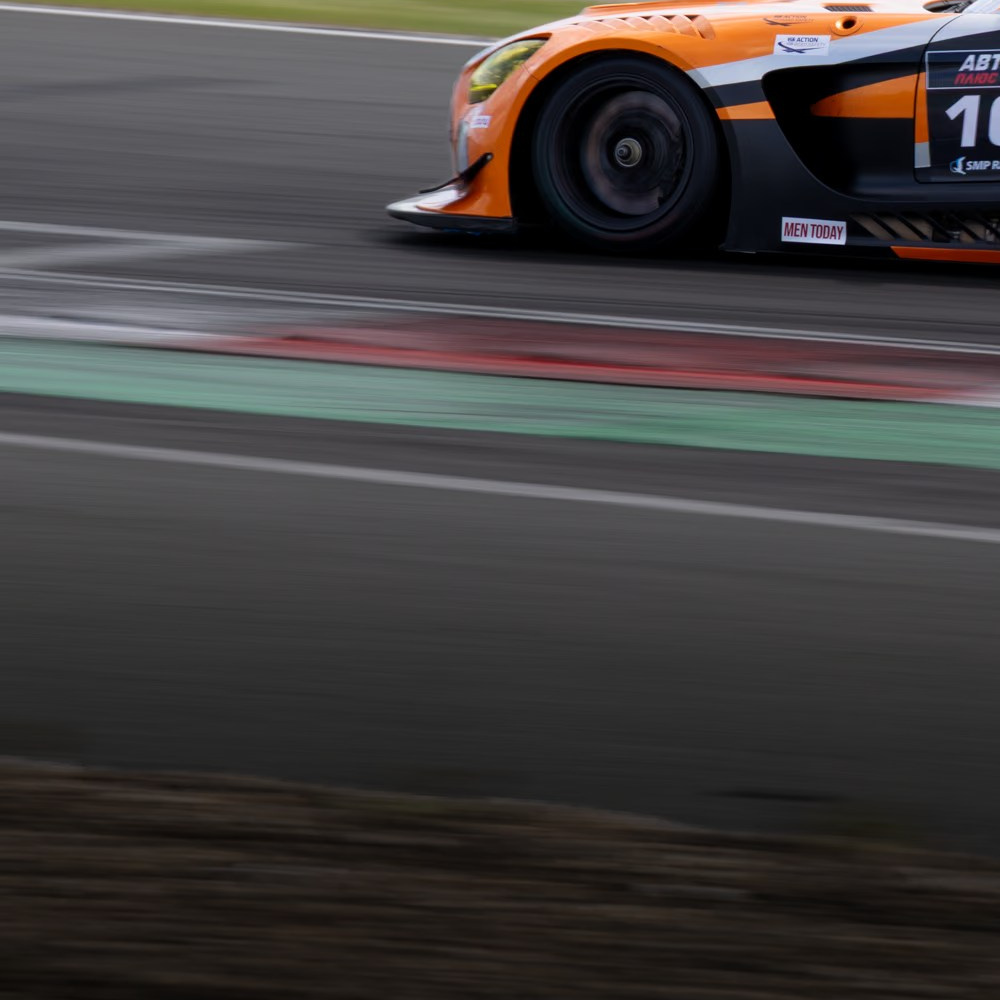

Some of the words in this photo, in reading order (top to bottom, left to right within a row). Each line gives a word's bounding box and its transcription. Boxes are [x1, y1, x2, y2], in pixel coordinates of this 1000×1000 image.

[954, 72, 999, 85] ПЛЮС
[965, 160, 991, 171] SMP
[783, 222, 808, 238] MEN
[810, 224, 844, 240] TODAY
